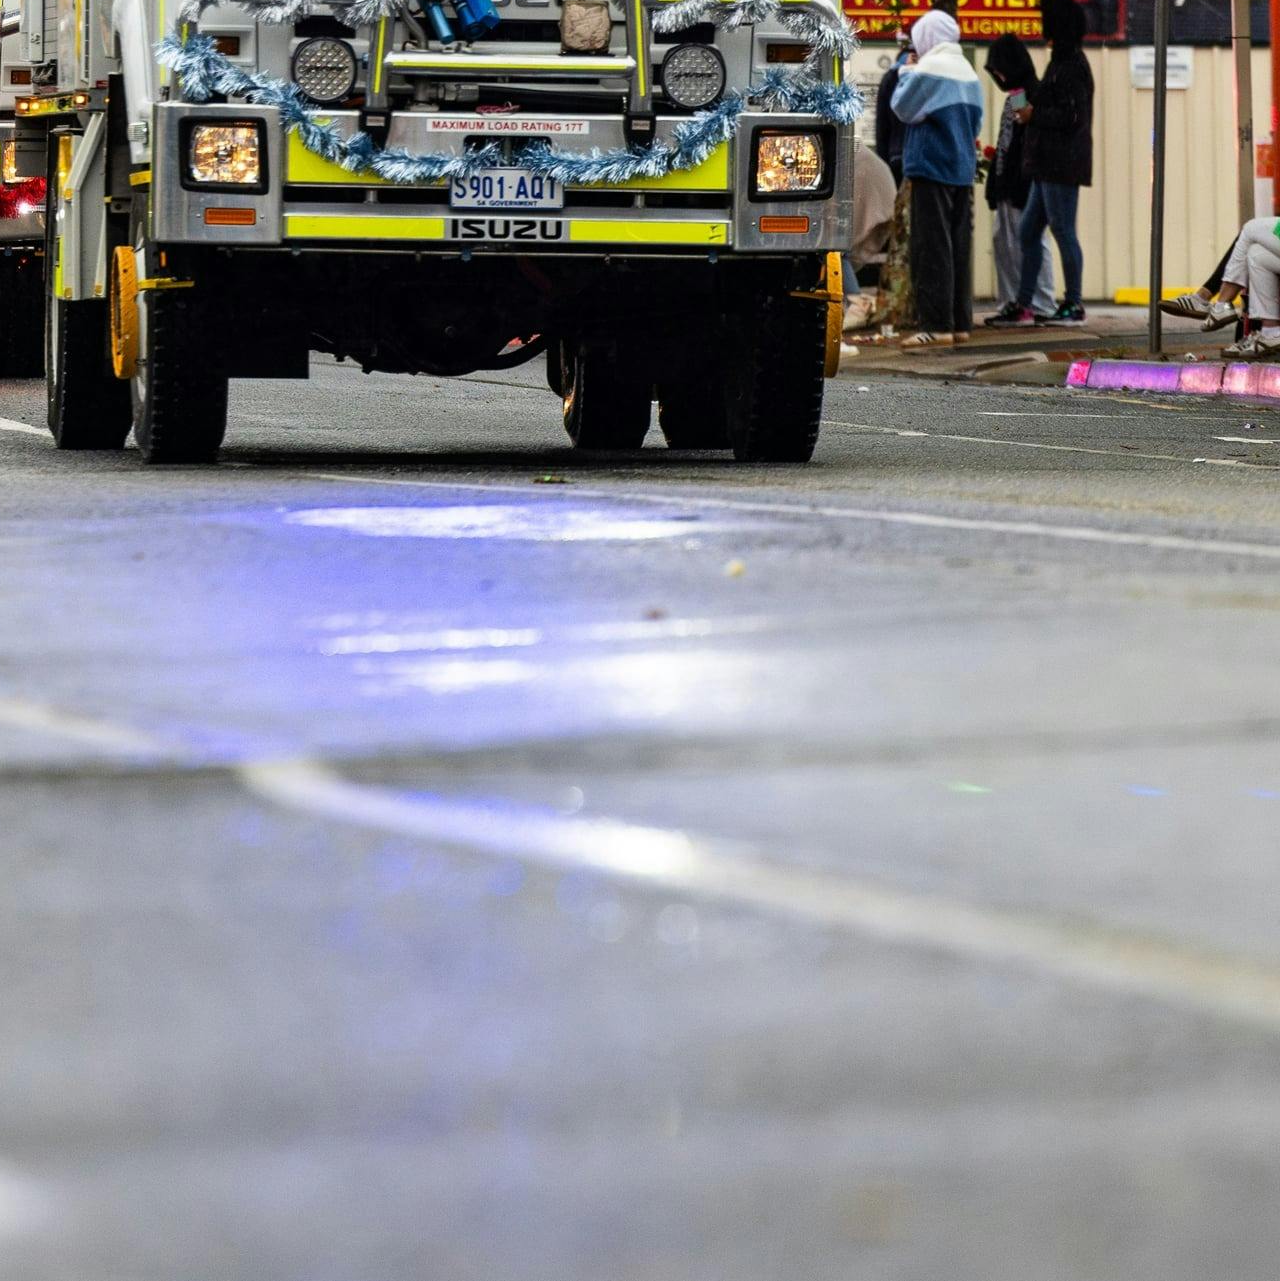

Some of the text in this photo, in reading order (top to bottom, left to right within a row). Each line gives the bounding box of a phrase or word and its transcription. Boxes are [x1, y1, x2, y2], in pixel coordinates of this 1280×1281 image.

[432, 121, 584, 132] MAXIMUM LOAD RATING 17T
[451, 219, 563, 240] ISUZU
